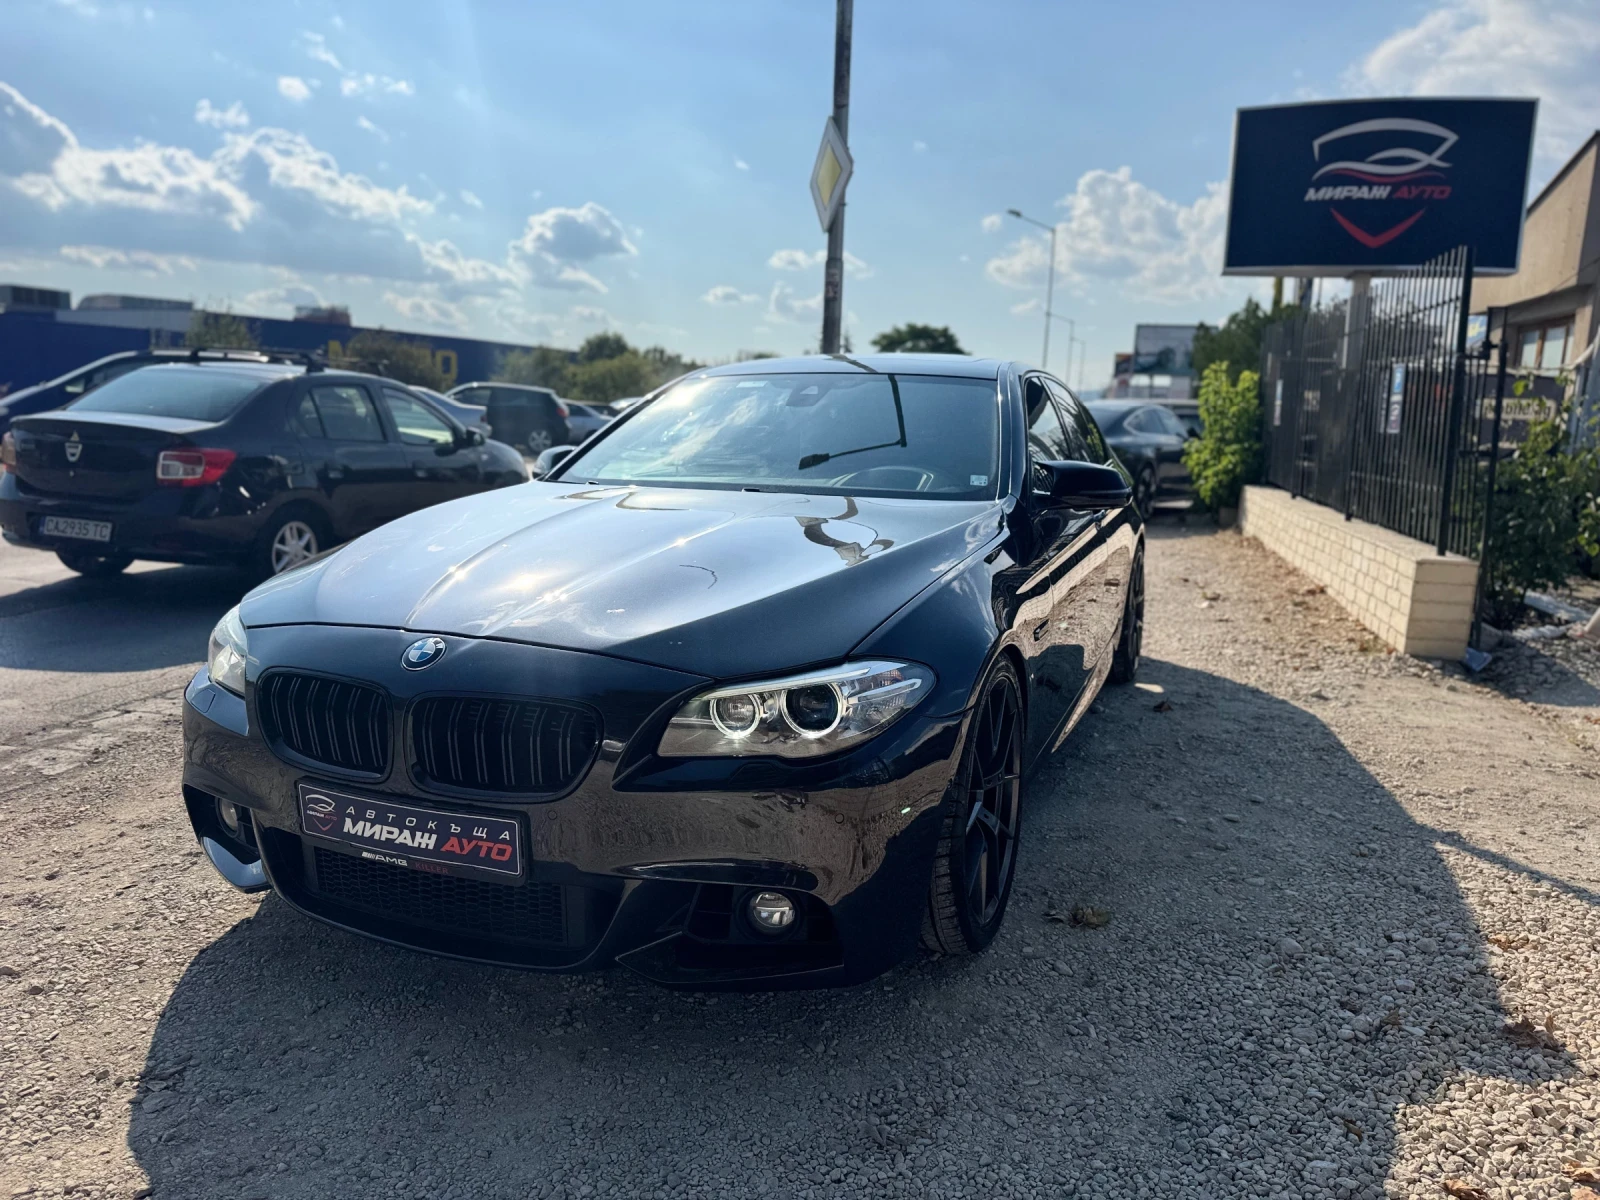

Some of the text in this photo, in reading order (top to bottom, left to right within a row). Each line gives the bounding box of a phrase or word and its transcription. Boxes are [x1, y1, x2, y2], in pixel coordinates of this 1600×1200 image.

[1304, 185, 1452, 201] МИРАЖ АУТО
[343, 817, 512, 861] МИРАЖ АУТО
[374, 853, 449, 875] AMG KILLER
